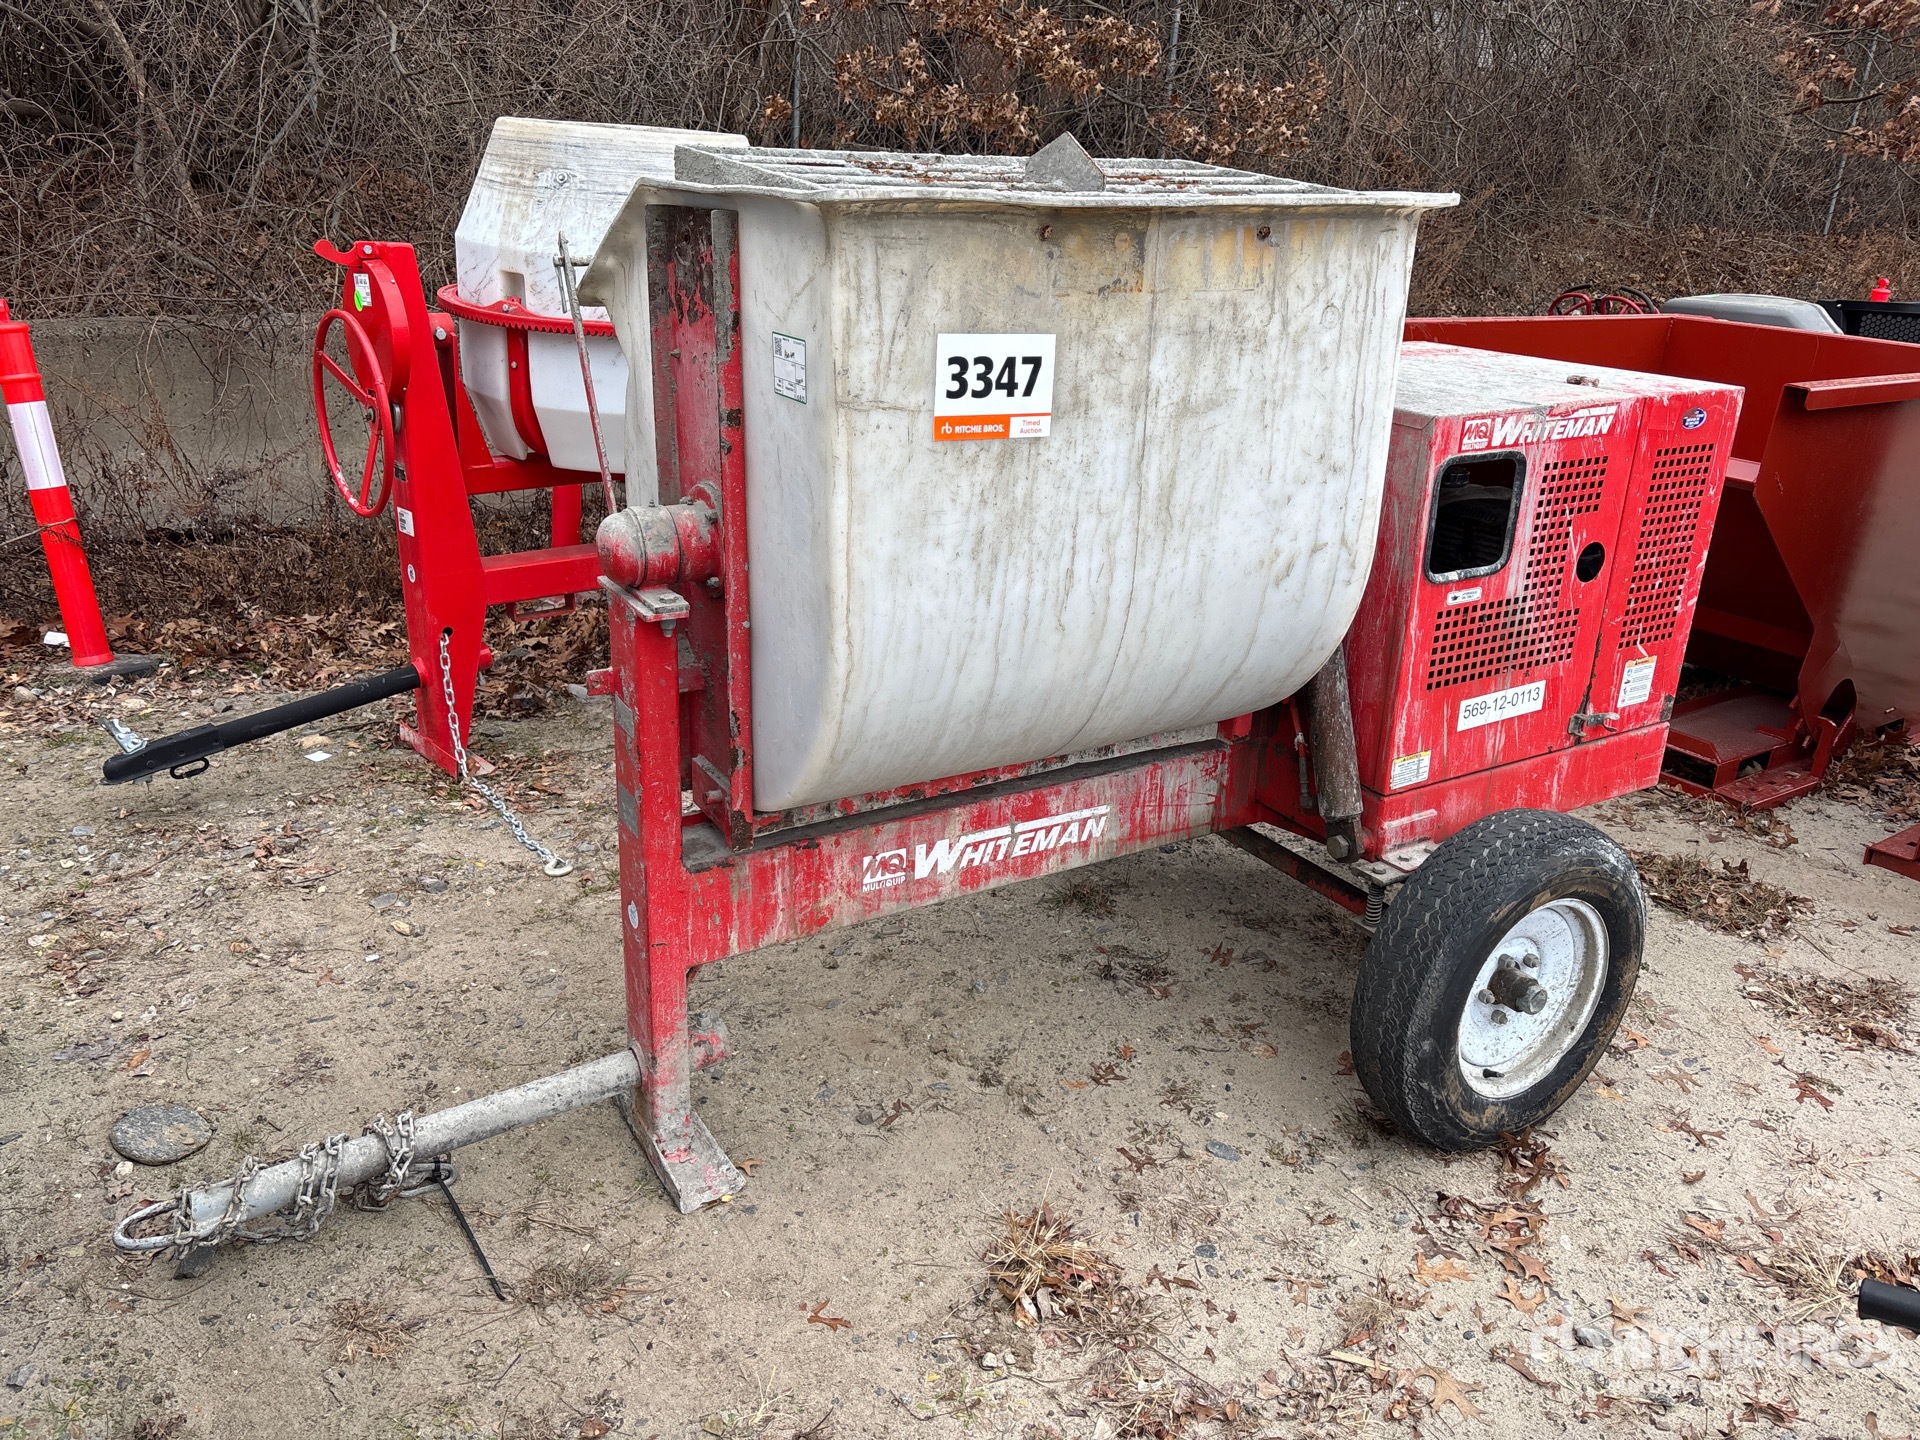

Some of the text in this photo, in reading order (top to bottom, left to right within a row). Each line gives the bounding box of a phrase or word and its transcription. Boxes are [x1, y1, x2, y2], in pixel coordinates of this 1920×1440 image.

[945, 355, 1042, 399] 3347
[954, 425, 982, 433] RITCHIE
[1463, 687, 1541, 719] 569-12-0113
[914, 804, 1110, 880] WHITEMAN
